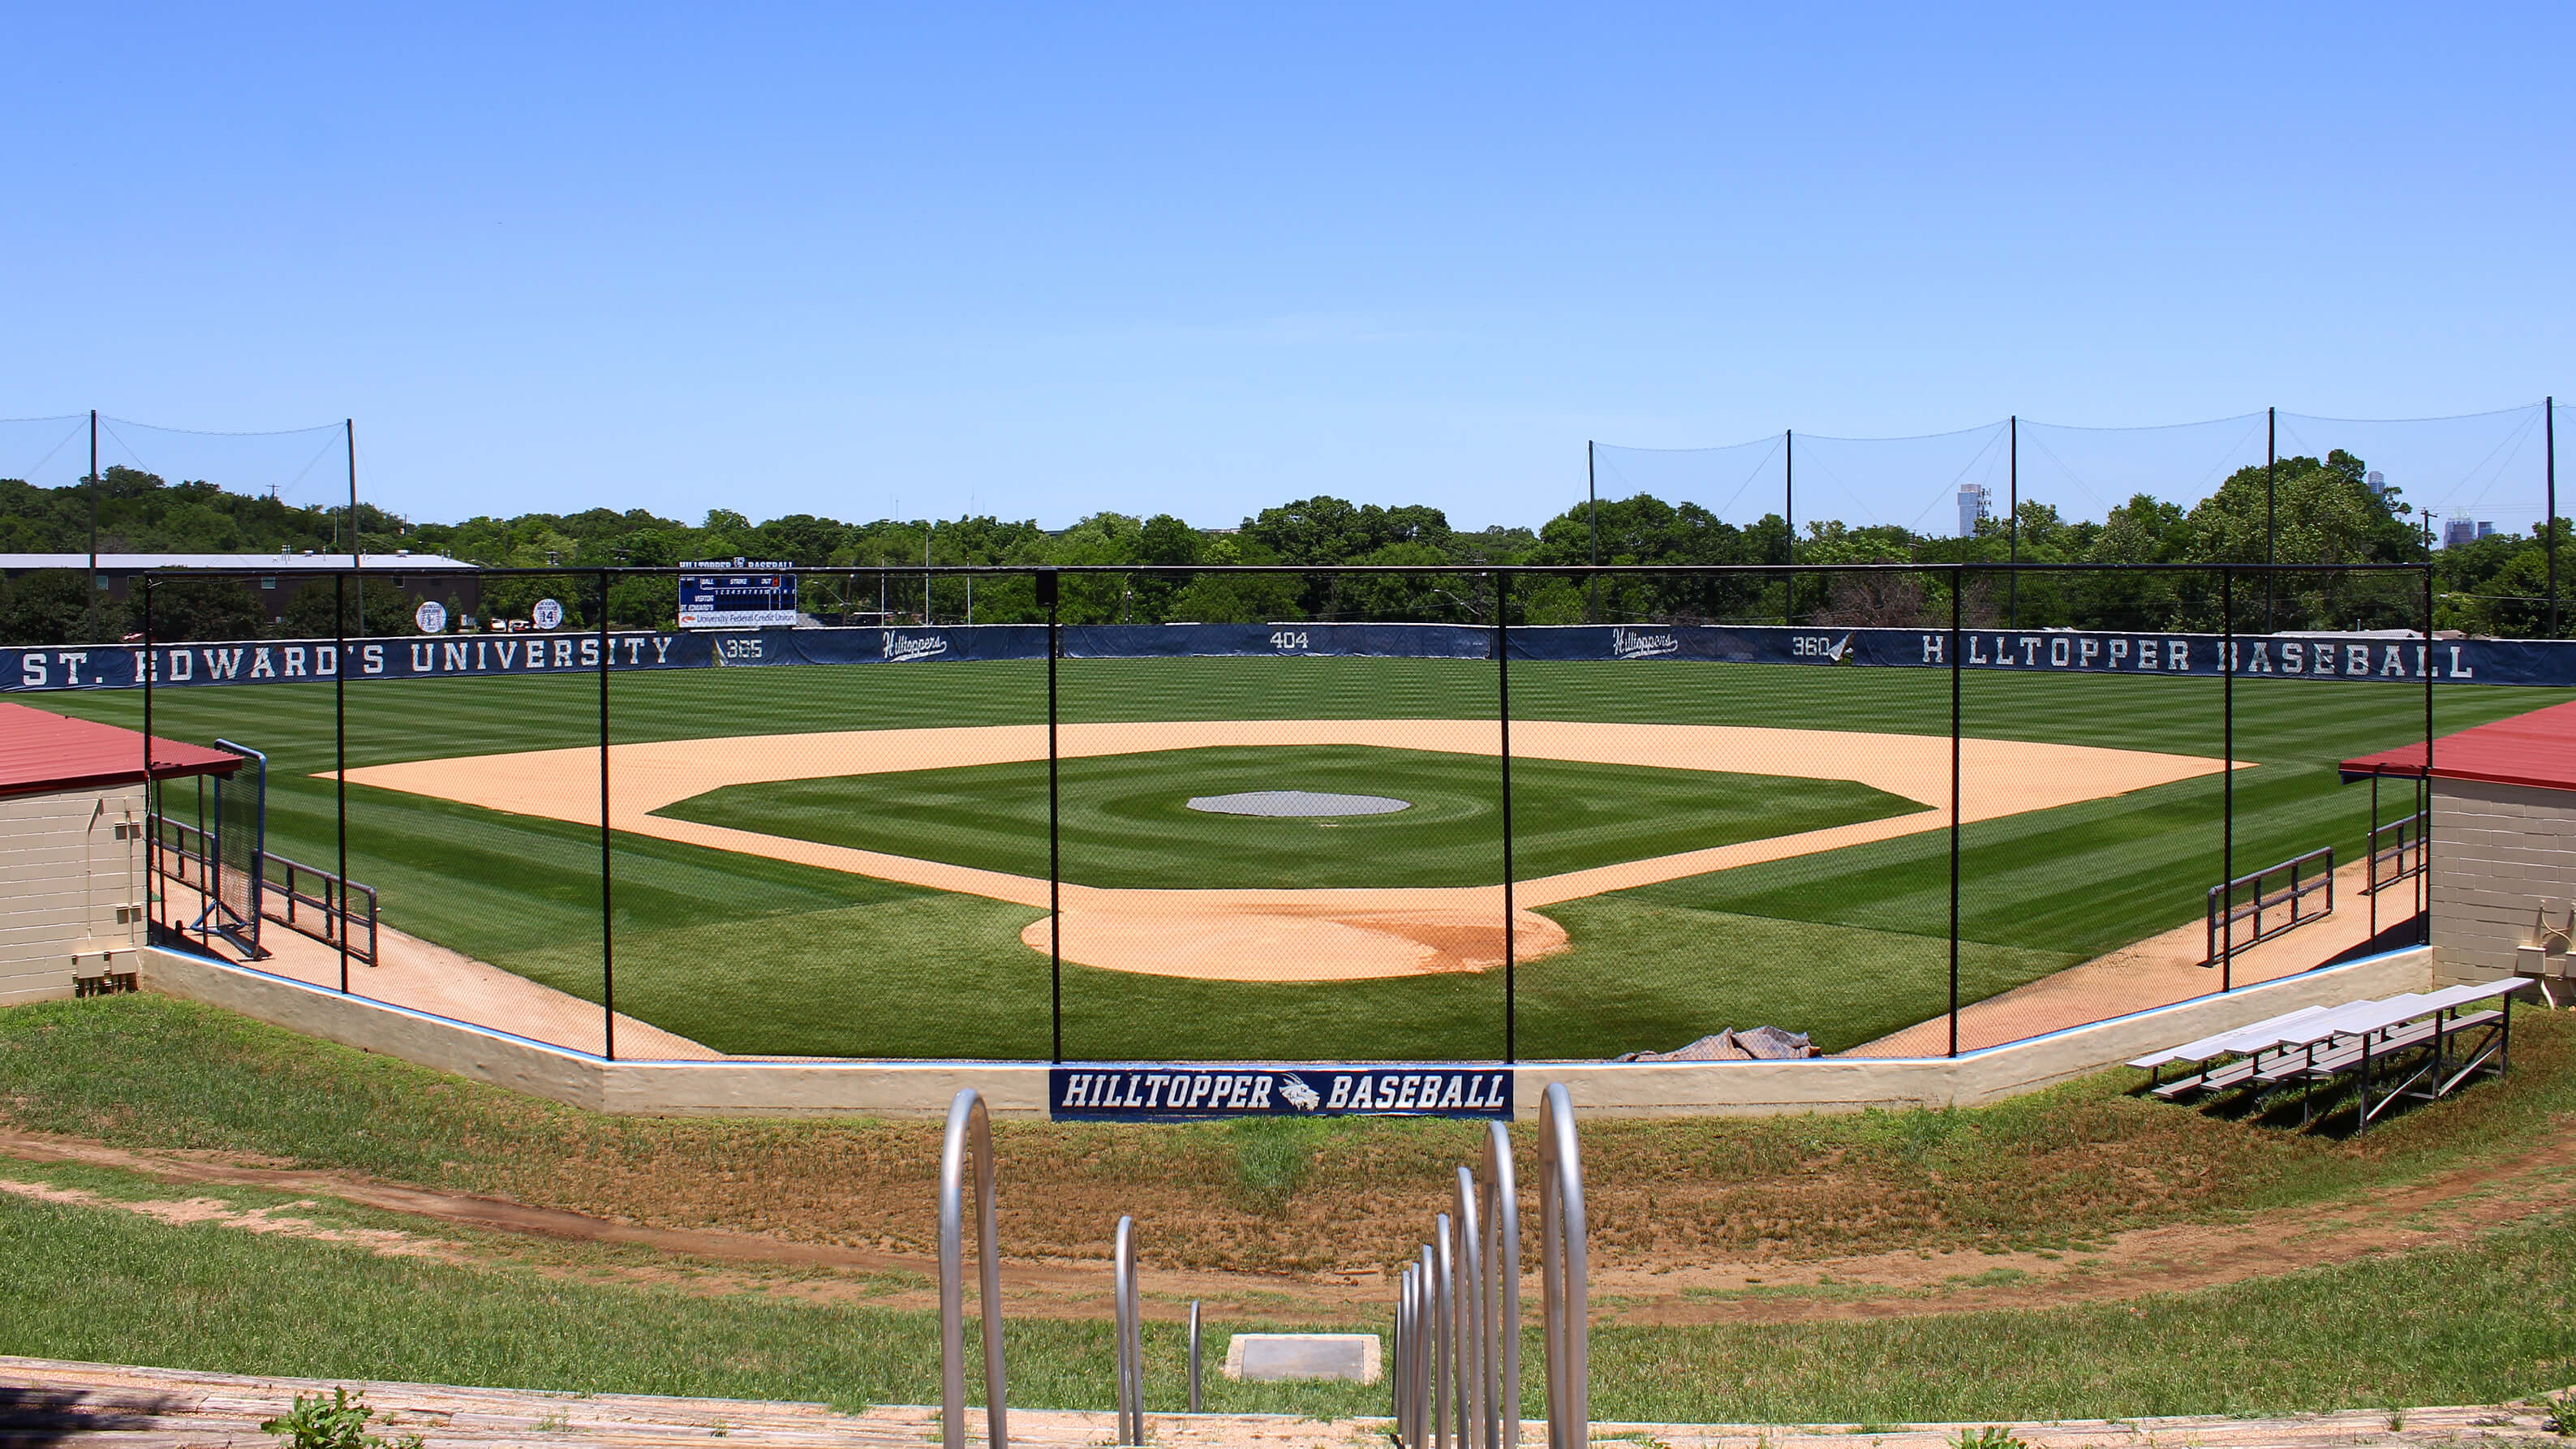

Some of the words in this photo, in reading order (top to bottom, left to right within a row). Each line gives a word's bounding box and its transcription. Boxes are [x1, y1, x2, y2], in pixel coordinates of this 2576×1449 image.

[697, 614, 729, 624] University
[730, 614, 753, 622] Federal
[754, 613, 774, 621] Credit
[776, 613, 794, 621] Union
[727, 639, 763, 658] 365
[883, 630, 947, 660] Hilltoppers
[1270, 632, 1309, 648] 404
[1613, 627, 1678, 656] Hilltoppers
[1792, 636, 1830, 656] 360
[22, 652, 104, 686] ST.
[134, 645, 384, 683] EDWARD'S
[411, 636, 673, 673] UNIVERSITY
[1922, 635, 2190, 670] HLLTOPPER
[2217, 641, 2473, 678] BASEBALL
[1062, 1073, 1272, 1109] HILLTOPPER
[1327, 1074, 1505, 1110] BASEBALL
